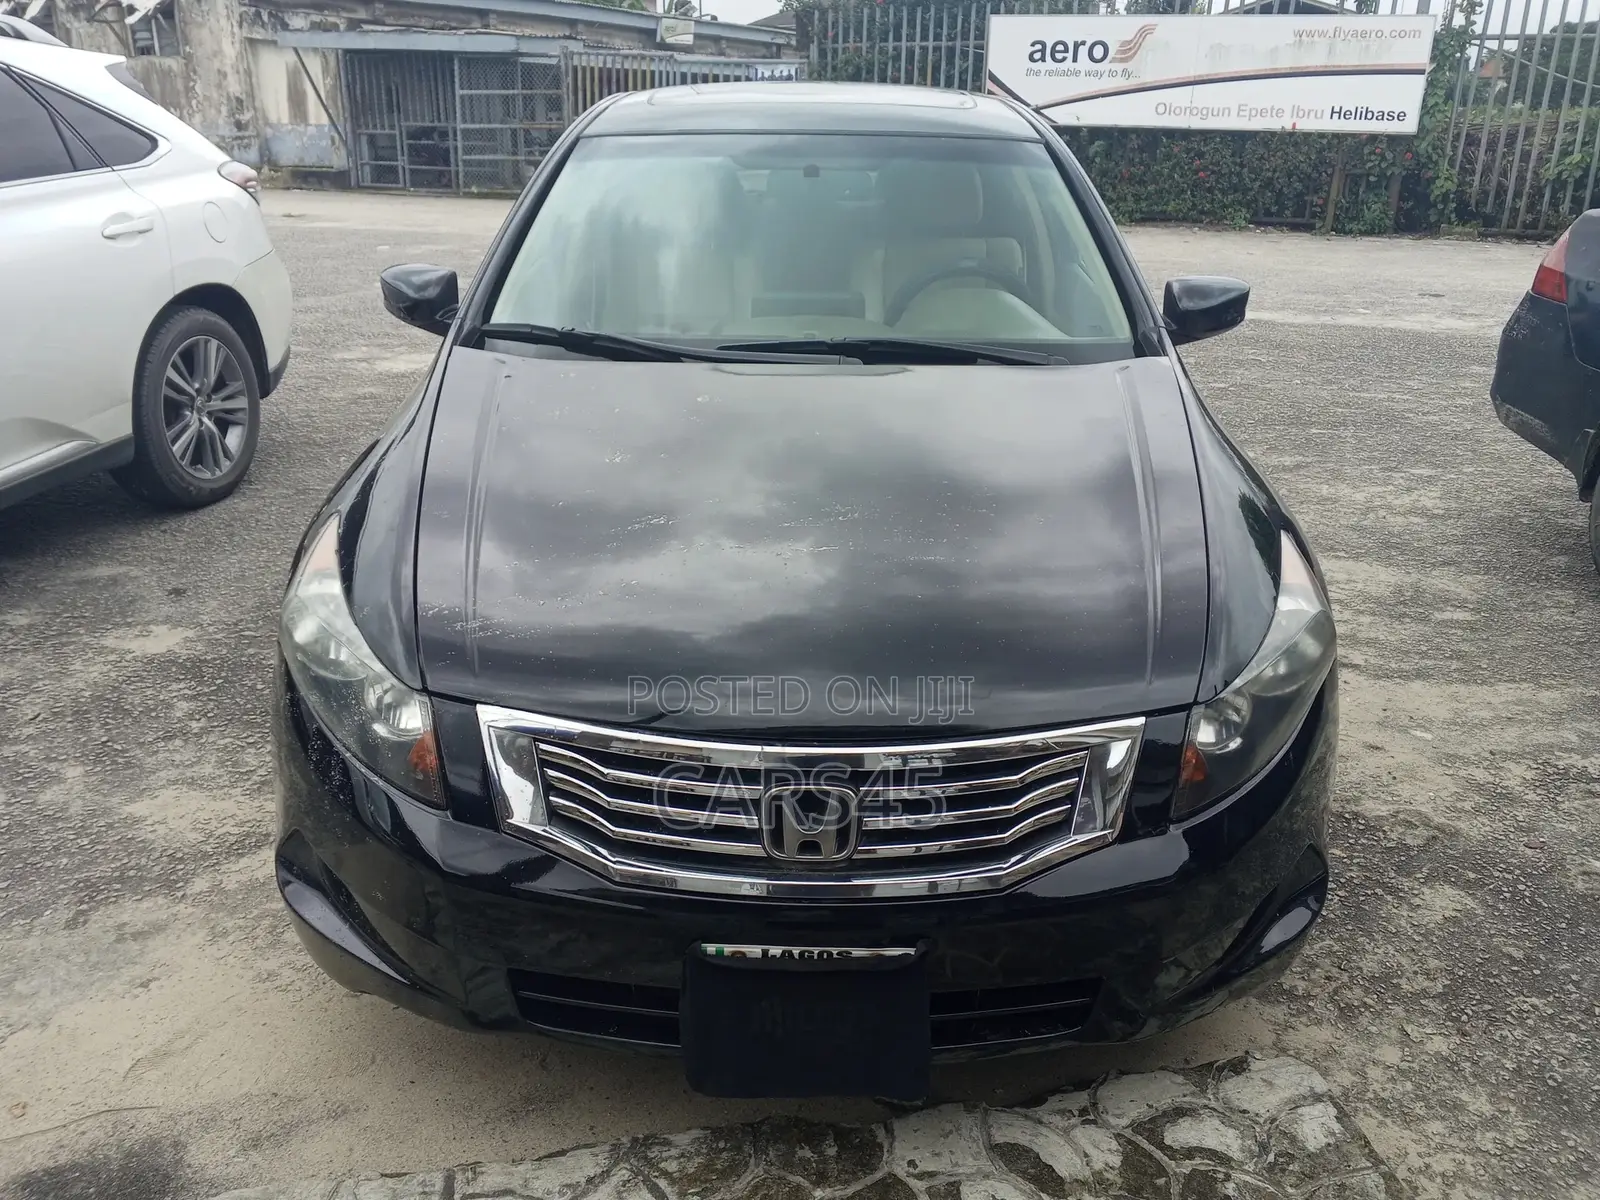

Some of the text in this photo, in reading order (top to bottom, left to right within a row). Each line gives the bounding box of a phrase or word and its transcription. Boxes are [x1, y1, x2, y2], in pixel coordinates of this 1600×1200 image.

[1293, 26, 1422, 41] www.flyaero.com
[1028, 39, 1110, 64] aero
[1025, 67, 1042, 77] the
[1043, 67, 1082, 78] reliable
[1084, 69, 1106, 80] way
[1107, 68, 1118, 78] to
[1154, 101, 1407, 122] Olorogun Epete Ibru Helibase
